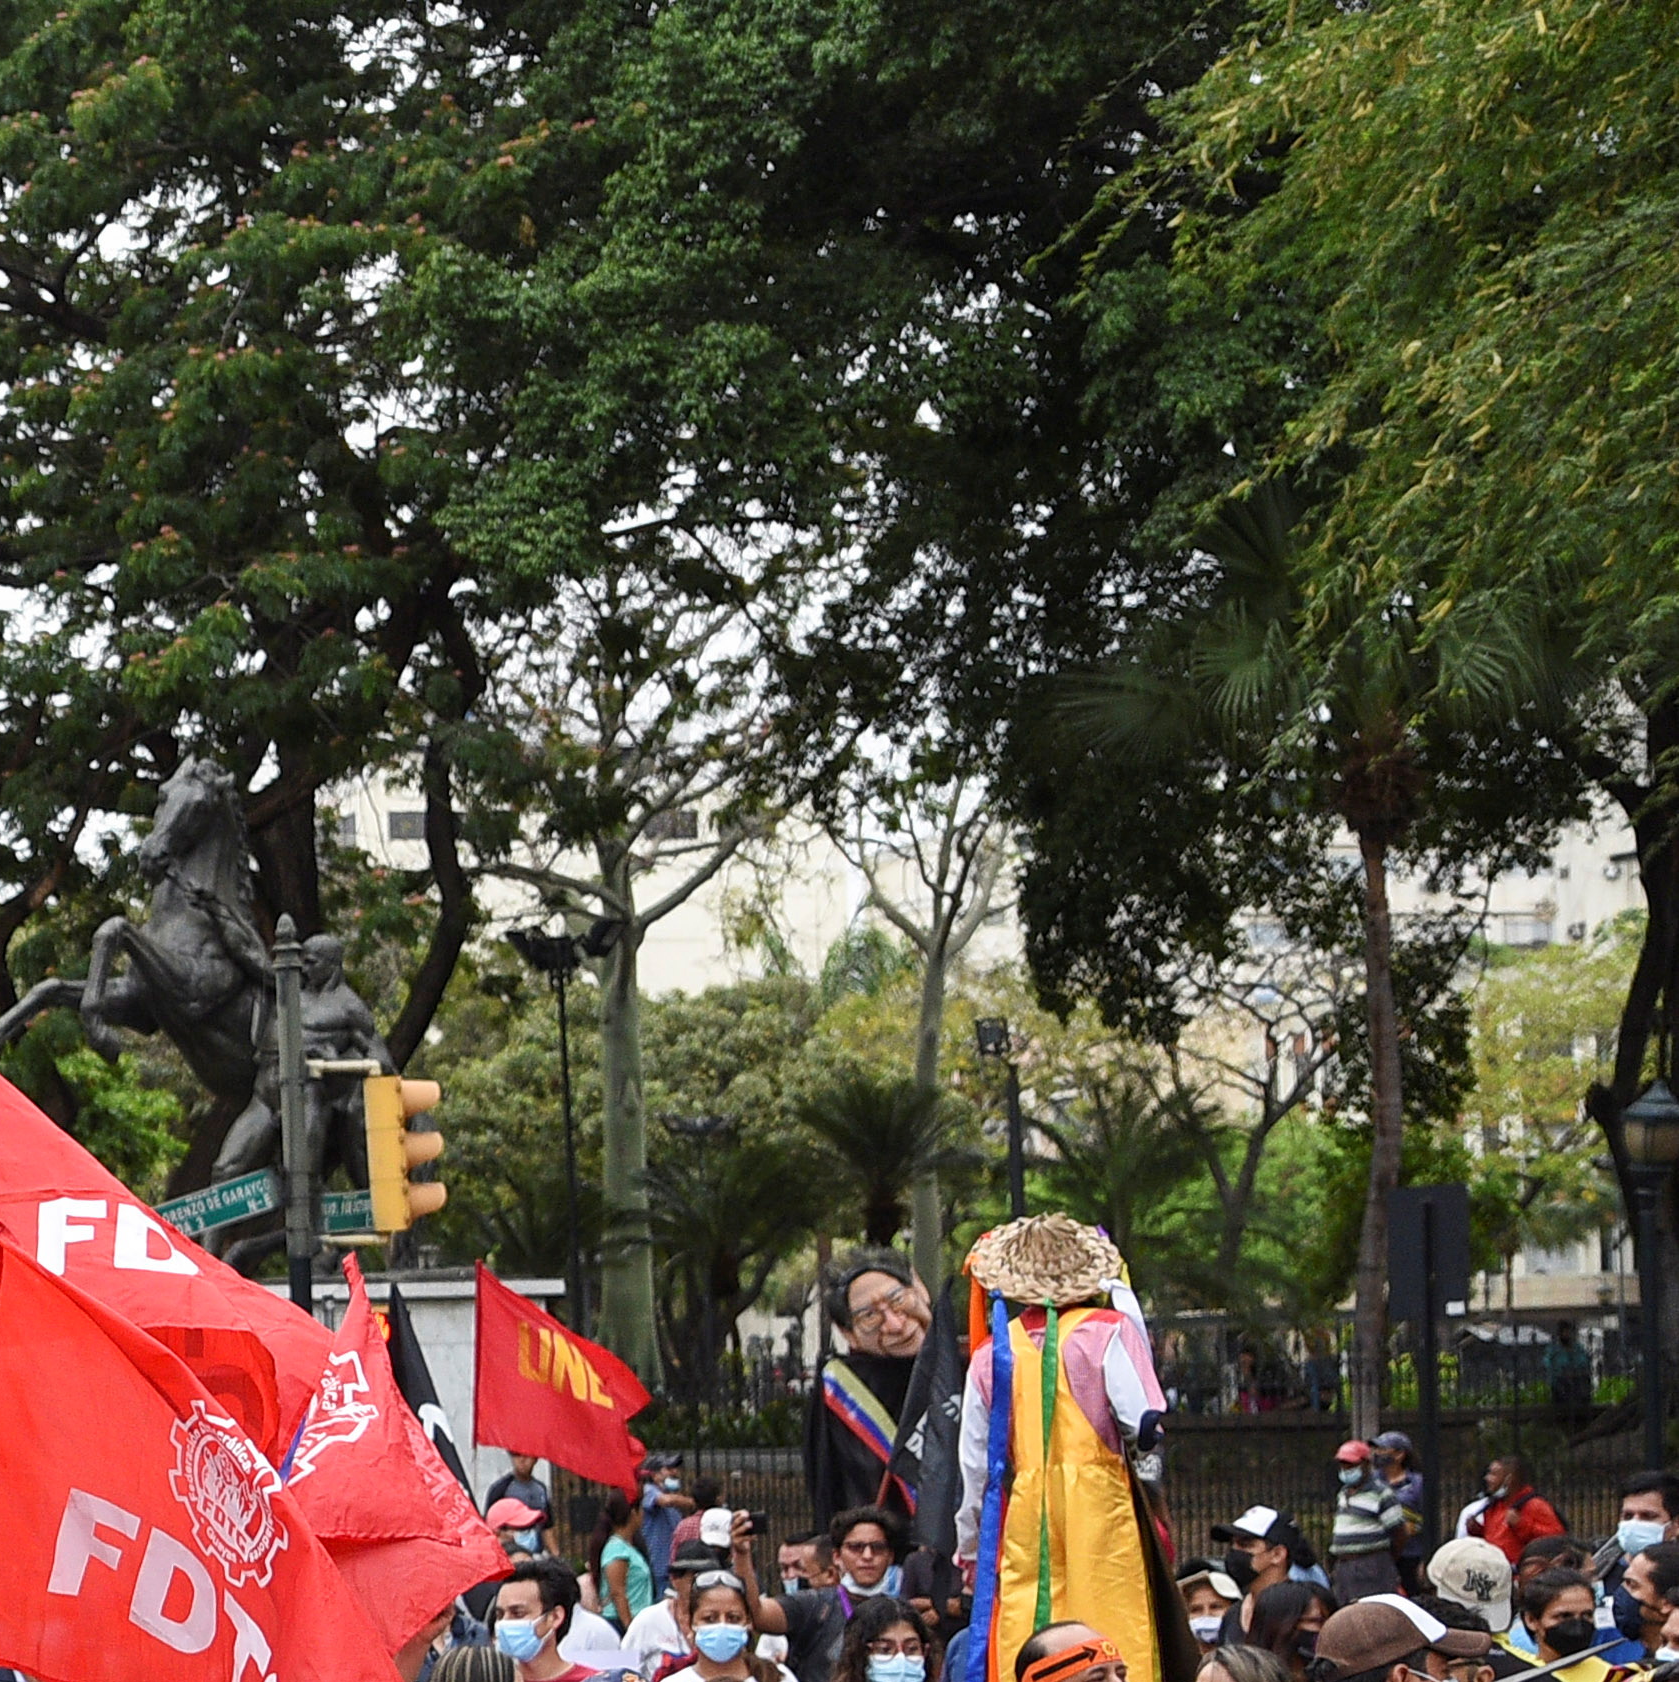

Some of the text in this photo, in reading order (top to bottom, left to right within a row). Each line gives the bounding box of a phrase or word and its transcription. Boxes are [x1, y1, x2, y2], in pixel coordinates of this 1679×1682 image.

[161, 1201, 206, 1223] ORENZO
[206, 1193, 223, 1210] DE
[518, 1321, 614, 1411] UNE
